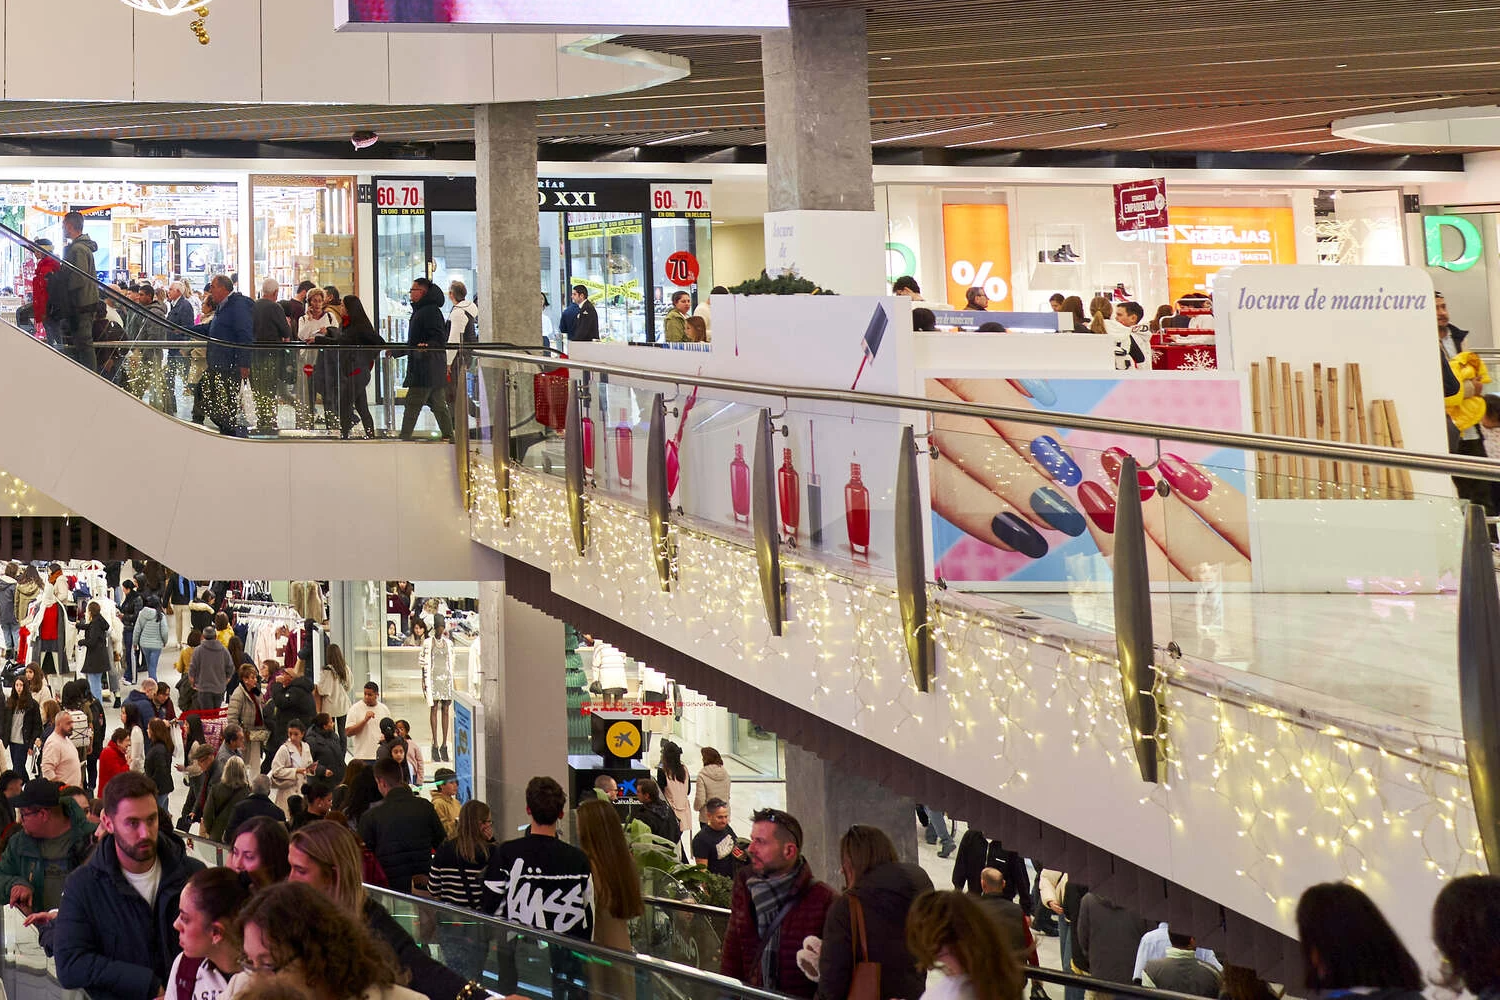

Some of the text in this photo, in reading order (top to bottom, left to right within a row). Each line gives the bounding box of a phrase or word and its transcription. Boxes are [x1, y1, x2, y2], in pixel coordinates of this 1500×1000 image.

[377, 186, 419, 206] 60 70
[553, 191, 597, 207] XXI
[654, 190, 702, 209] 60 70
[668, 258, 688, 281] 70
[1237, 286, 1428, 311] locura de manicura
[631, 706, 674, 717] 2025!
